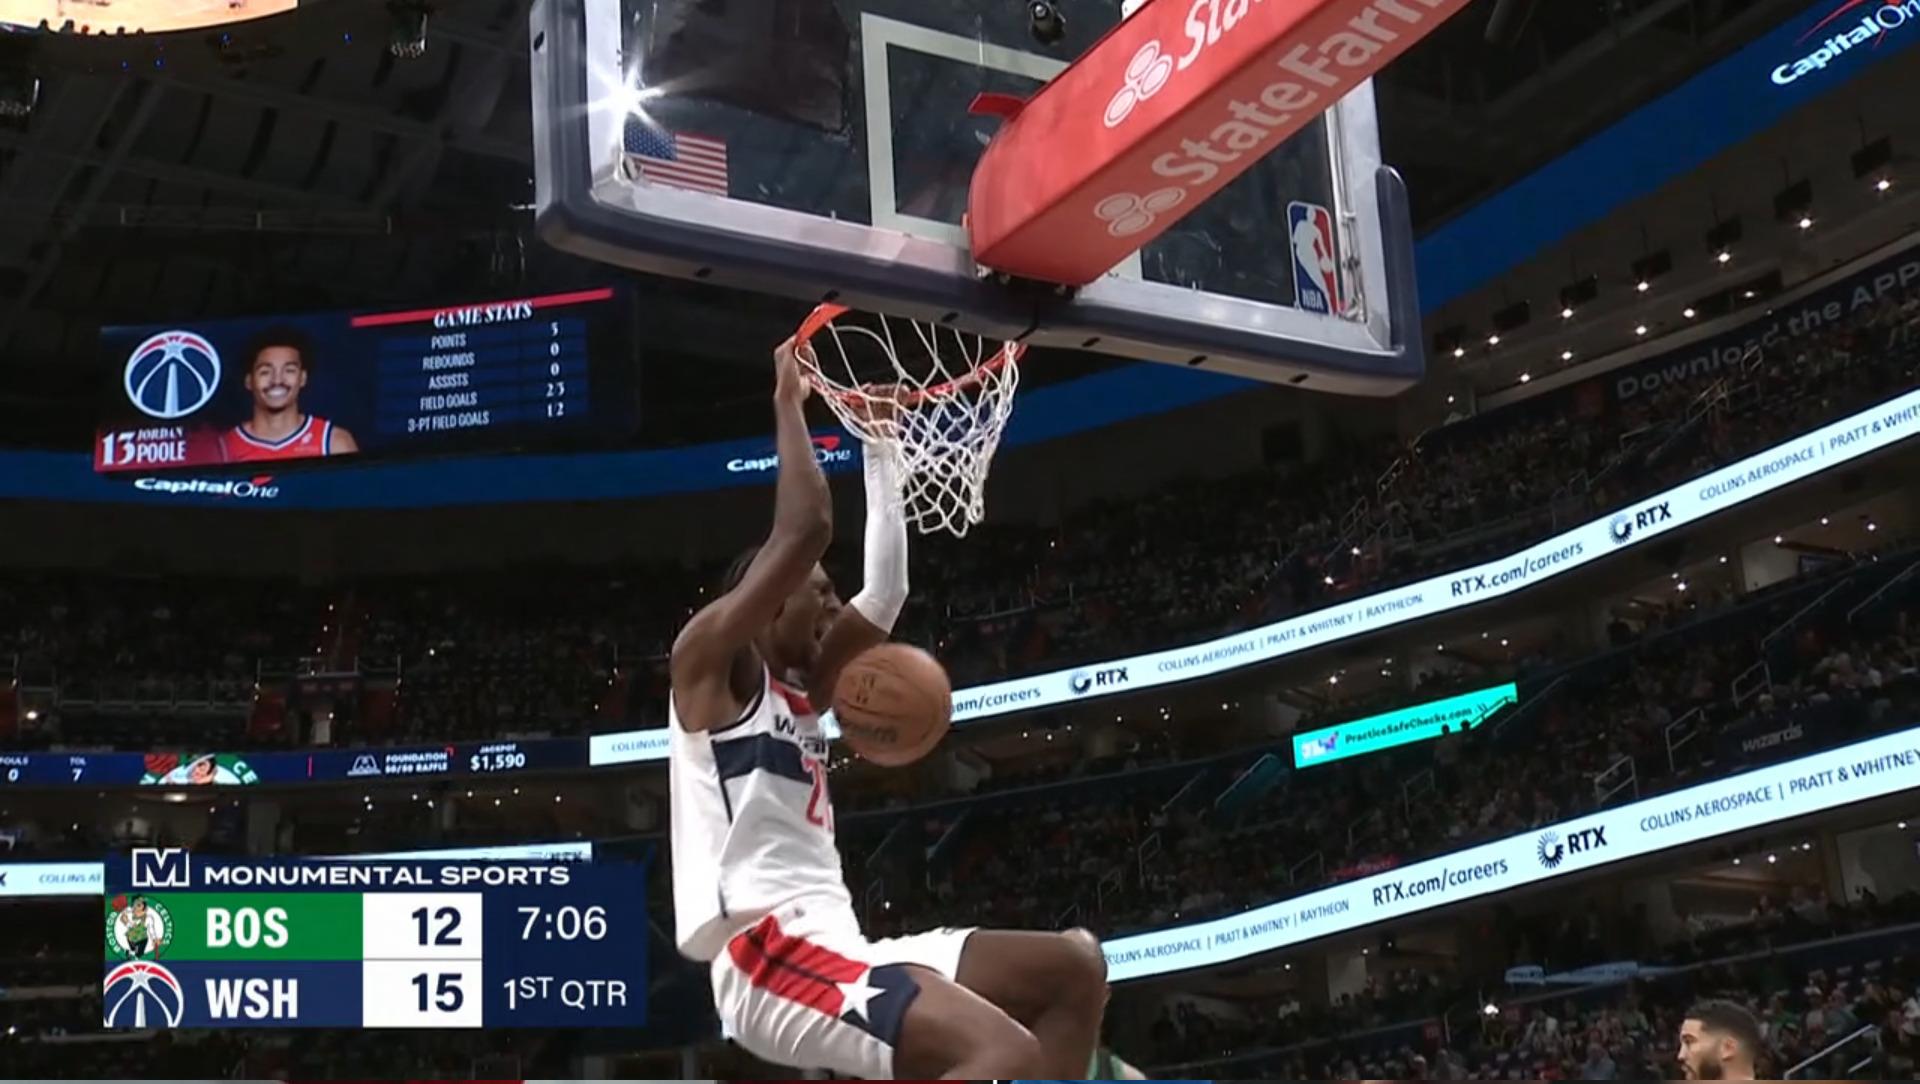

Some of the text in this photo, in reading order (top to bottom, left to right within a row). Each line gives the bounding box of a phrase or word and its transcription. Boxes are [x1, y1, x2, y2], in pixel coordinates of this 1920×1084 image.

[1302, 289, 1325, 311] NBA
[434, 301, 533, 328] GAME STATS
[1788, 300, 1842, 337] the
[431, 333, 467, 349] POINTS
[422, 342, 560, 370] REBOUNDS 0
[428, 362, 560, 390] ASSISTS 0
[420, 396, 445, 411] FIELD
[446, 392, 478, 408] GOALS
[137, 426, 184, 441] JORDAN
[408, 416, 430, 432] 3-PT
[432, 414, 457, 430] FIELD
[458, 411, 489, 428] GOALS
[102, 431, 137, 466] 13
[136, 441, 186, 464] POOLE
[1699, 475, 1746, 502] COLLINS
[1748, 445, 1816, 483] AEROSPACE
[1829, 424, 1869, 451] PRATT
[1871, 420, 1881, 434] &
[1636, 502, 1672, 530] RTX
[1451, 541, 1584, 598] RTX.com/careers
[1158, 655, 1201, 673] COLLINS
[1202, 640, 1256, 665] AEROSPACE
[1267, 628, 1297, 647] PRATT
[1298, 627, 1307, 637] &
[1308, 612, 1354, 635] WHITNEY
[1365, 593, 1424, 619] RAYTHEON
[1096, 667, 1129, 687] RTX
[385, 752, 448, 764] FOUNDATION
[479, 743, 517, 755] JACKPOT
[8, 768, 83, 782] 0 7
[415, 761, 448, 773] RAFFLE
[470, 753, 526, 773] $1,590
[1640, 807, 1692, 832] COLLINS
[1694, 786, 1773, 818] AEROSPACE
[1789, 769, 1834, 793] PRATT
[1837, 764, 1849, 783] &
[1567, 826, 1608, 855] RTX
[39, 873, 86, 884] COLLINS
[1372, 858, 1509, 907] RTX.com/careers
[1143, 939, 1202, 959] AEROSPACE
[1215, 928, 1241, 946] PRATT
[1250, 915, 1291, 938] WHITNEY
[1300, 900, 1350, 923] RAYTHEON
